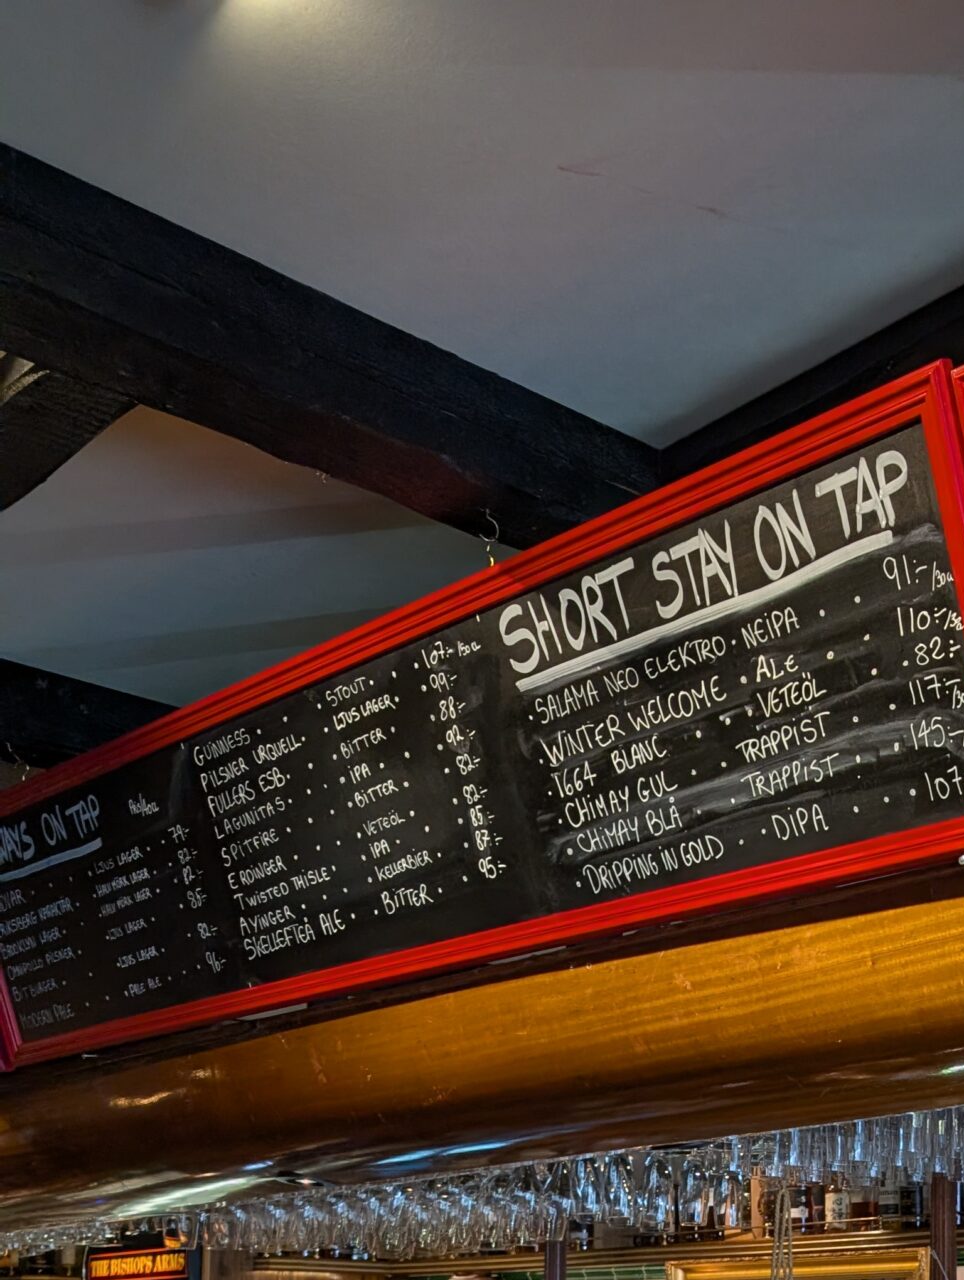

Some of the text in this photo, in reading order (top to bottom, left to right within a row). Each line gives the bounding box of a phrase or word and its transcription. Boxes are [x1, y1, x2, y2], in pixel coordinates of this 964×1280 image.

[499, 450, 908, 675] SHORT STAY ON TAP
[326, 677, 366, 707] STOUT
[534, 679, 600, 724] SALAMA
[603, 667, 640, 697] NEO
[644, 635, 726, 679] ELEKTRO
[627, 675, 727, 731] WELCOME
[756, 654, 799, 682] ALE
[252, 734, 302, 765] URQUELL
[360, 694, 396, 717] LAGER
[551, 761, 597, 798] 1664
[611, 735, 668, 774] BLANC
[757, 672, 828, 717] VETEÖL
[206, 780, 256, 818] FULLERS
[258, 767, 286, 792] ESB
[637, 771, 678, 802] GUL
[41, 804, 68, 846] ON
[65, 794, 101, 839] TAP
[363, 810, 406, 836] VETEÖL
[680, 835, 725, 867] GOLD
[319, 909, 346, 936] ALE
[90, 1252, 185, 1277] THE BISHOPS ARMS
